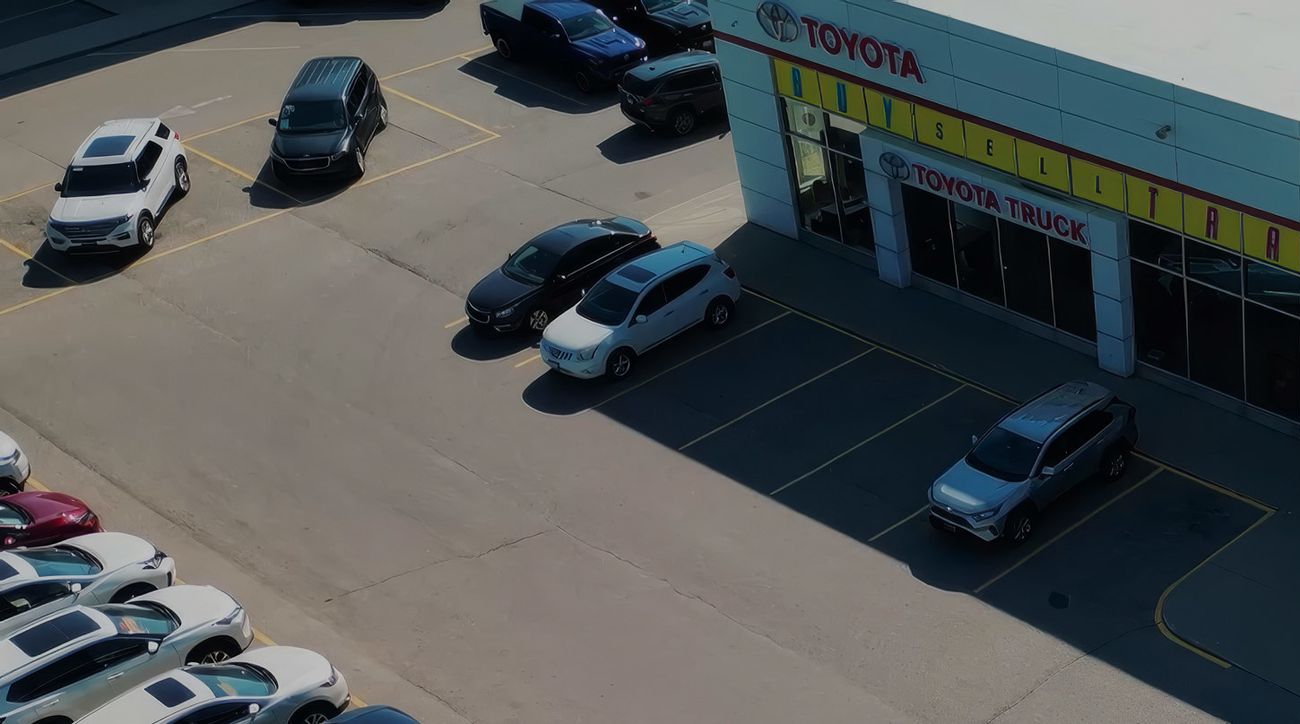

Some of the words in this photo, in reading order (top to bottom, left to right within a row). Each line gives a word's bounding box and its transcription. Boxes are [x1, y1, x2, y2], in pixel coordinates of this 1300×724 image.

[800, 16, 926, 84] TOYOTA
[935, 122, 1102, 194] SELL
[912, 163, 1000, 214] TOYOTA
[1005, 196, 1088, 246] TRUCK
